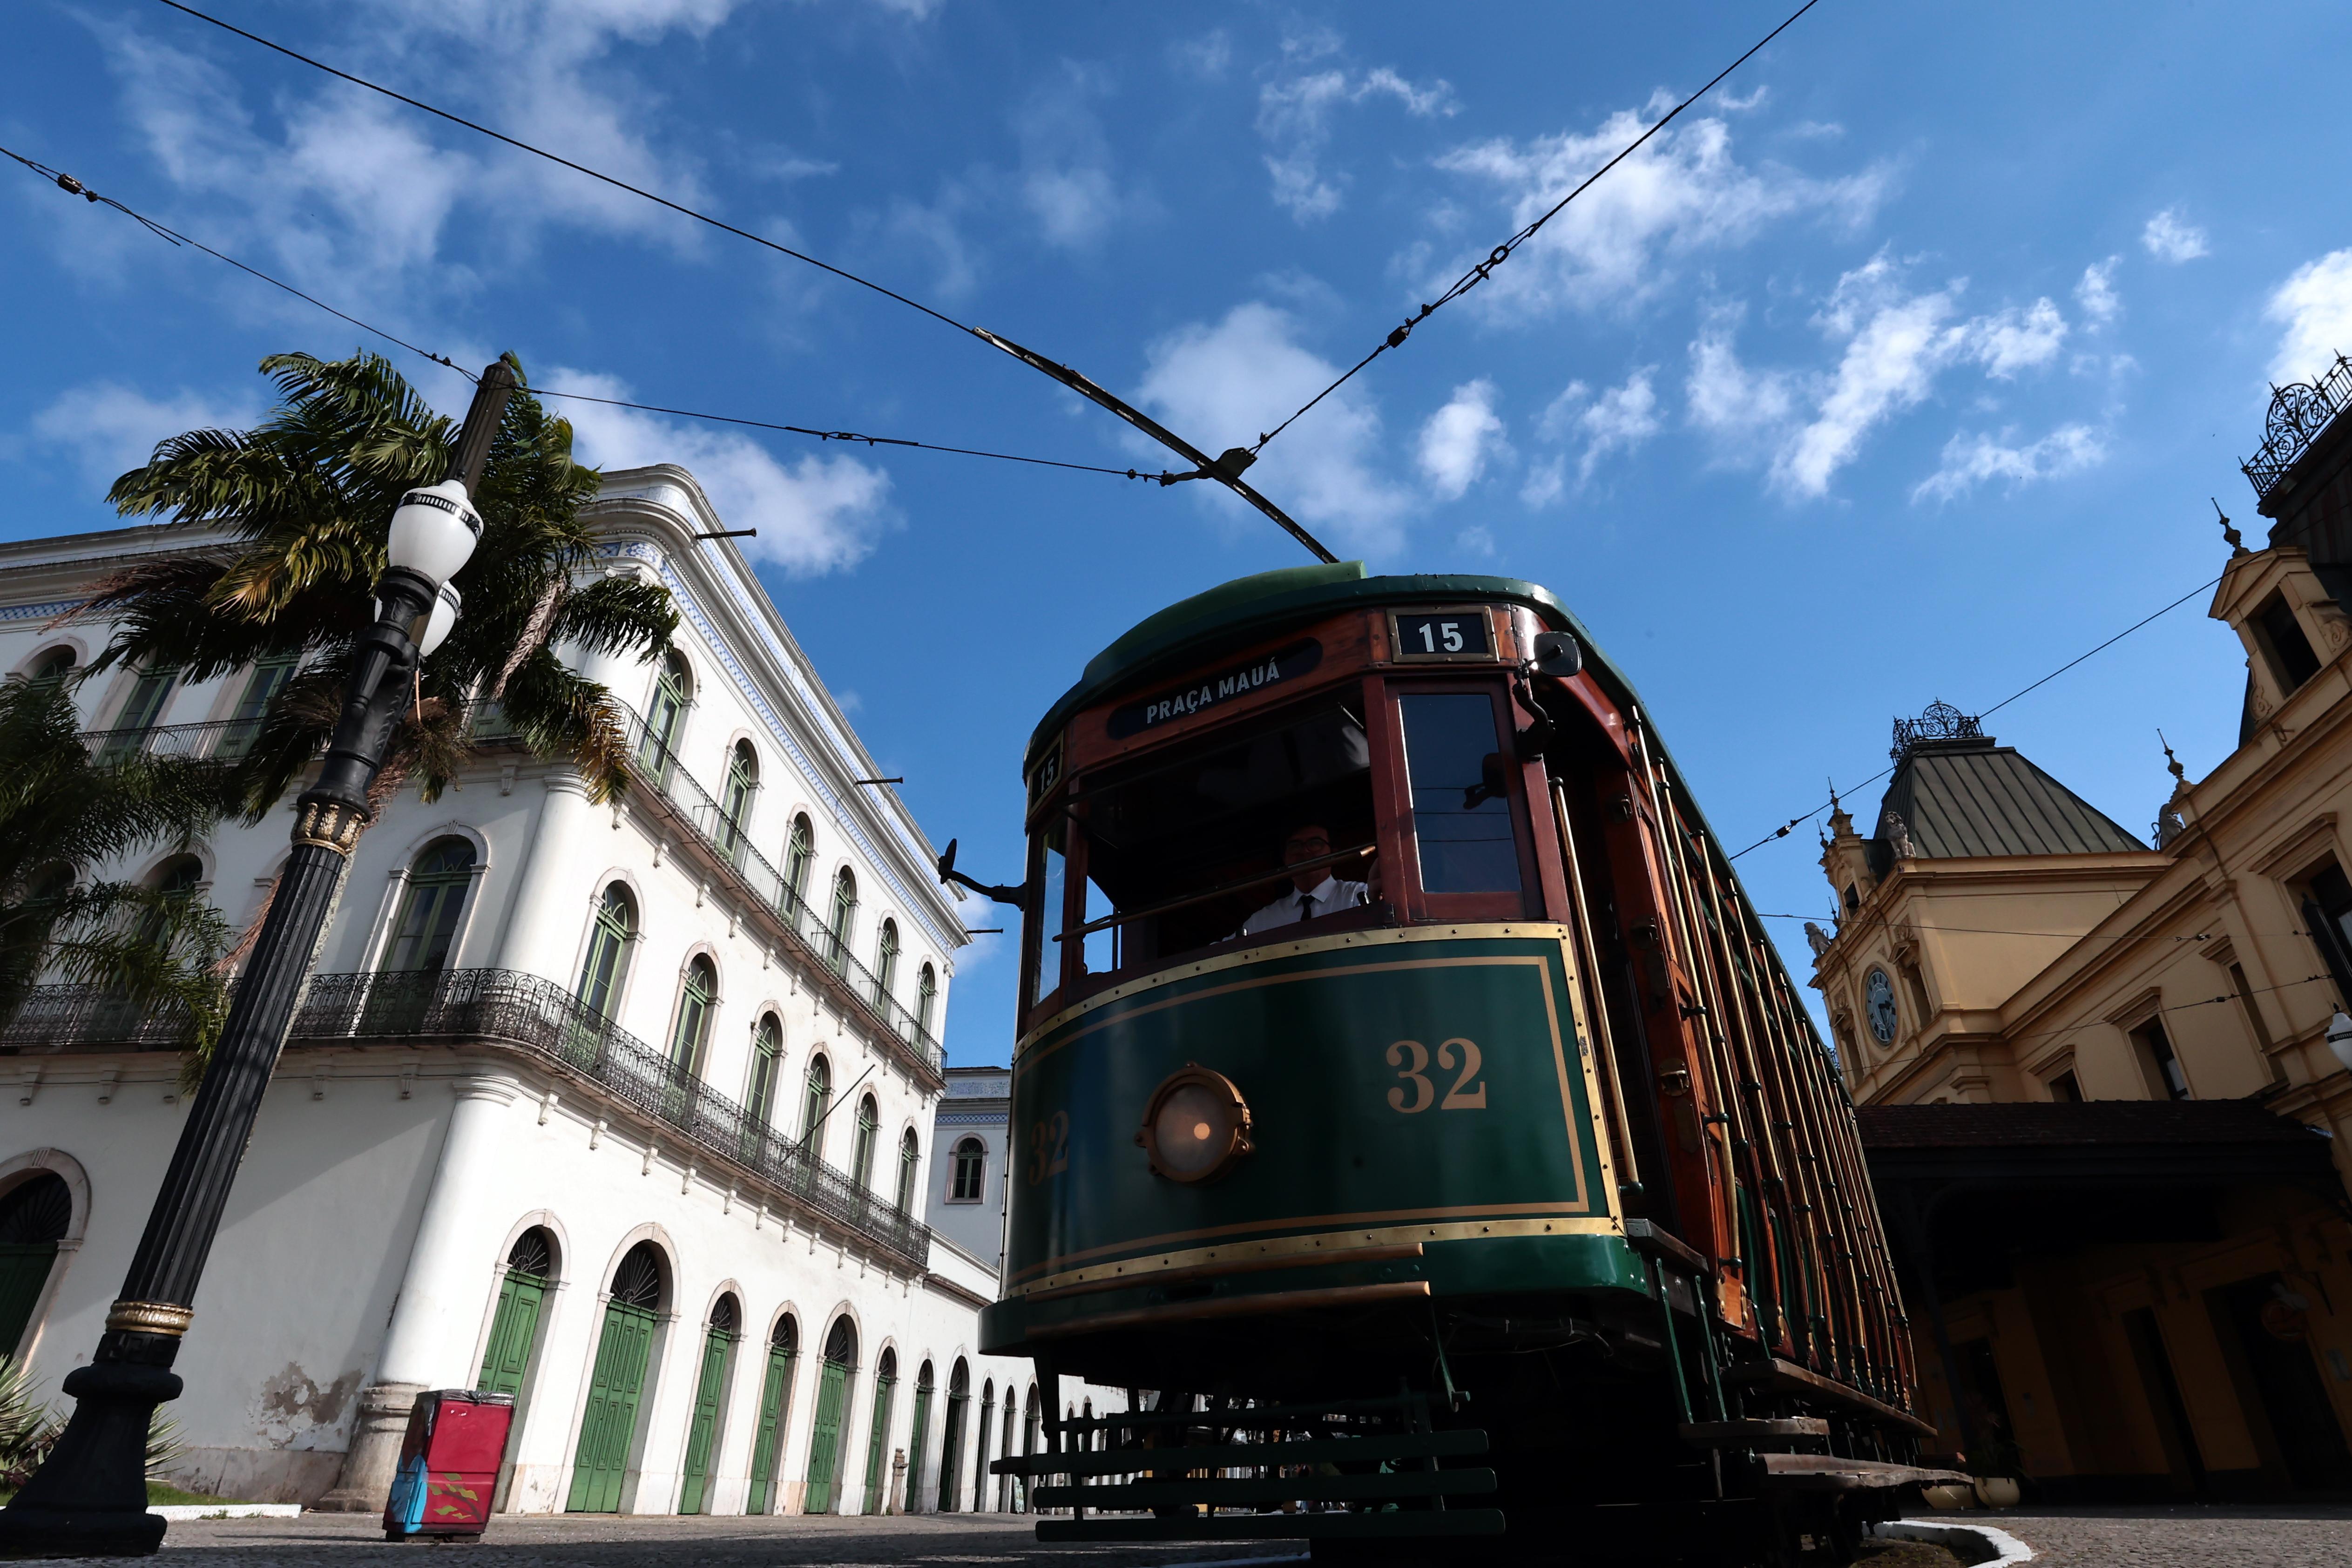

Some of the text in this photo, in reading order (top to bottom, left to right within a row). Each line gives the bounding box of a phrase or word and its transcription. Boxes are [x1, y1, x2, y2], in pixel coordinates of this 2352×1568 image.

[1419, 622, 1464, 652] 15
[1147, 656, 1280, 724] PRAÇA MAUÁ
[1041, 756, 1054, 794] 15
[1386, 1038, 1487, 1114] 32
[1028, 1110, 1069, 1186] 32
